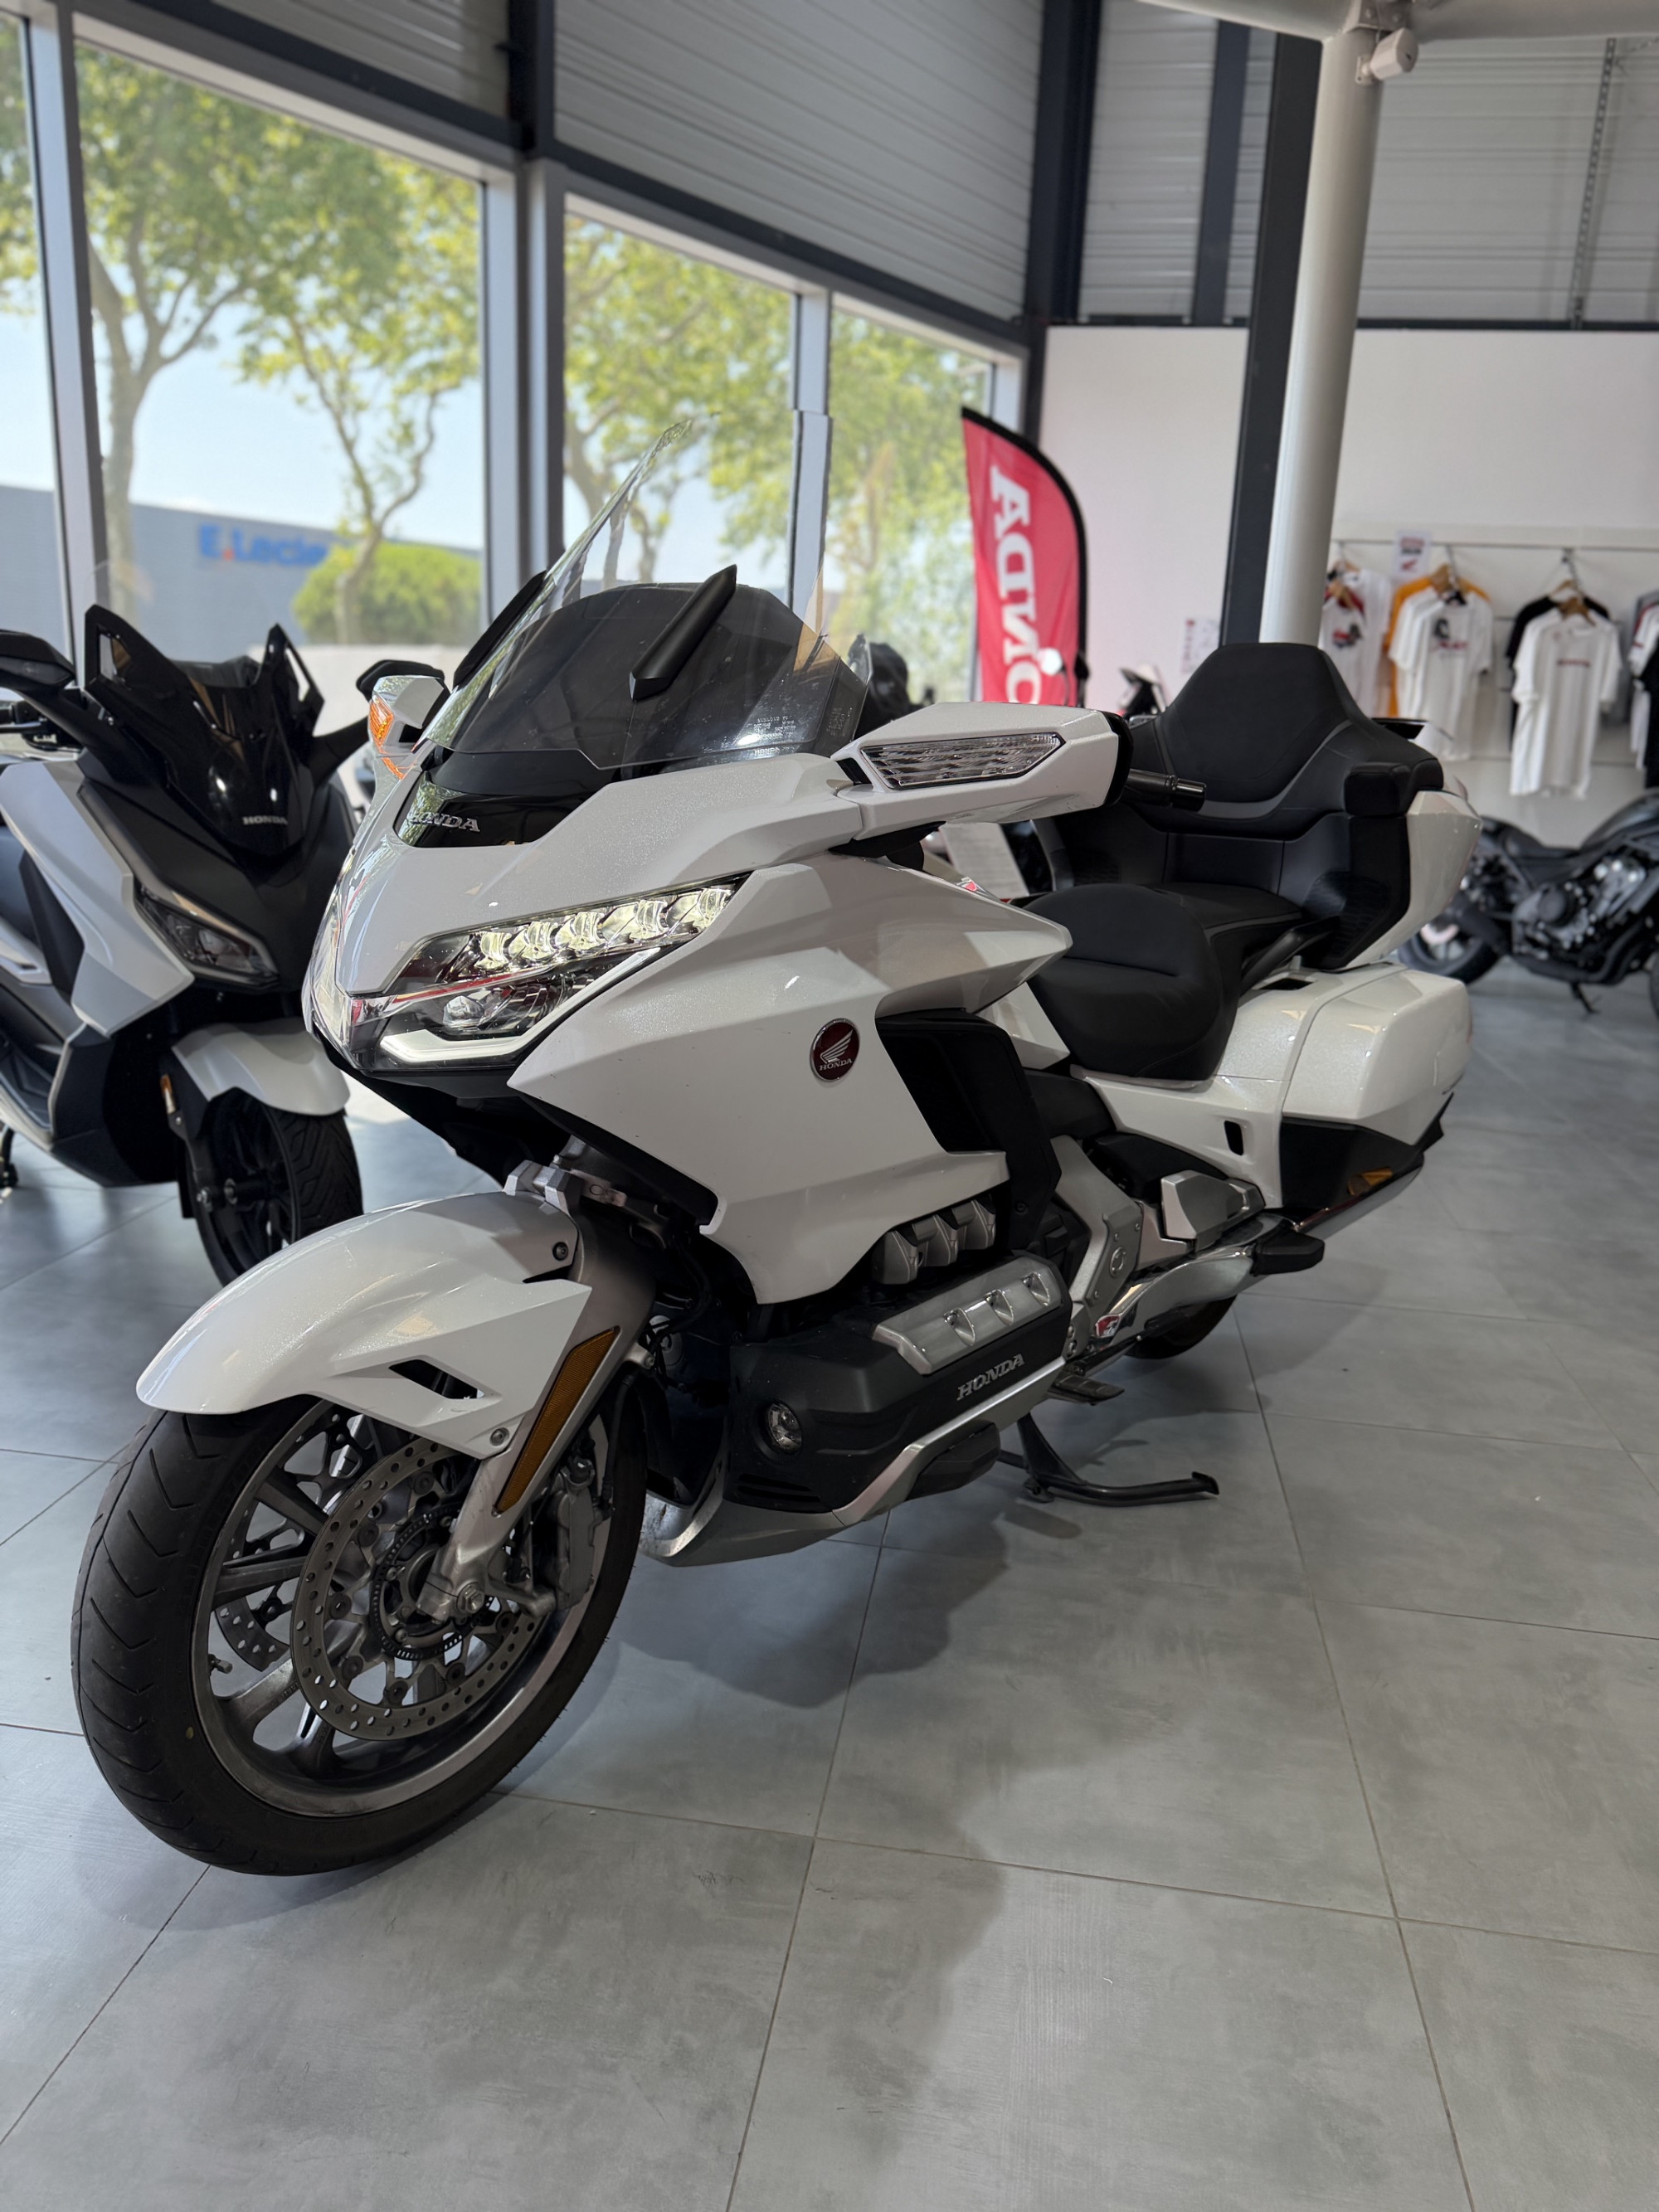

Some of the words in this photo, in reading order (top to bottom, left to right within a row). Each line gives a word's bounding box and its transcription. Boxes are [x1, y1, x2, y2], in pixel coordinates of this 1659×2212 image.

[242, 815, 288, 825] HONDA
[819, 1058, 853, 1071] HONDA
[956, 1354, 1025, 1401] HONDA
